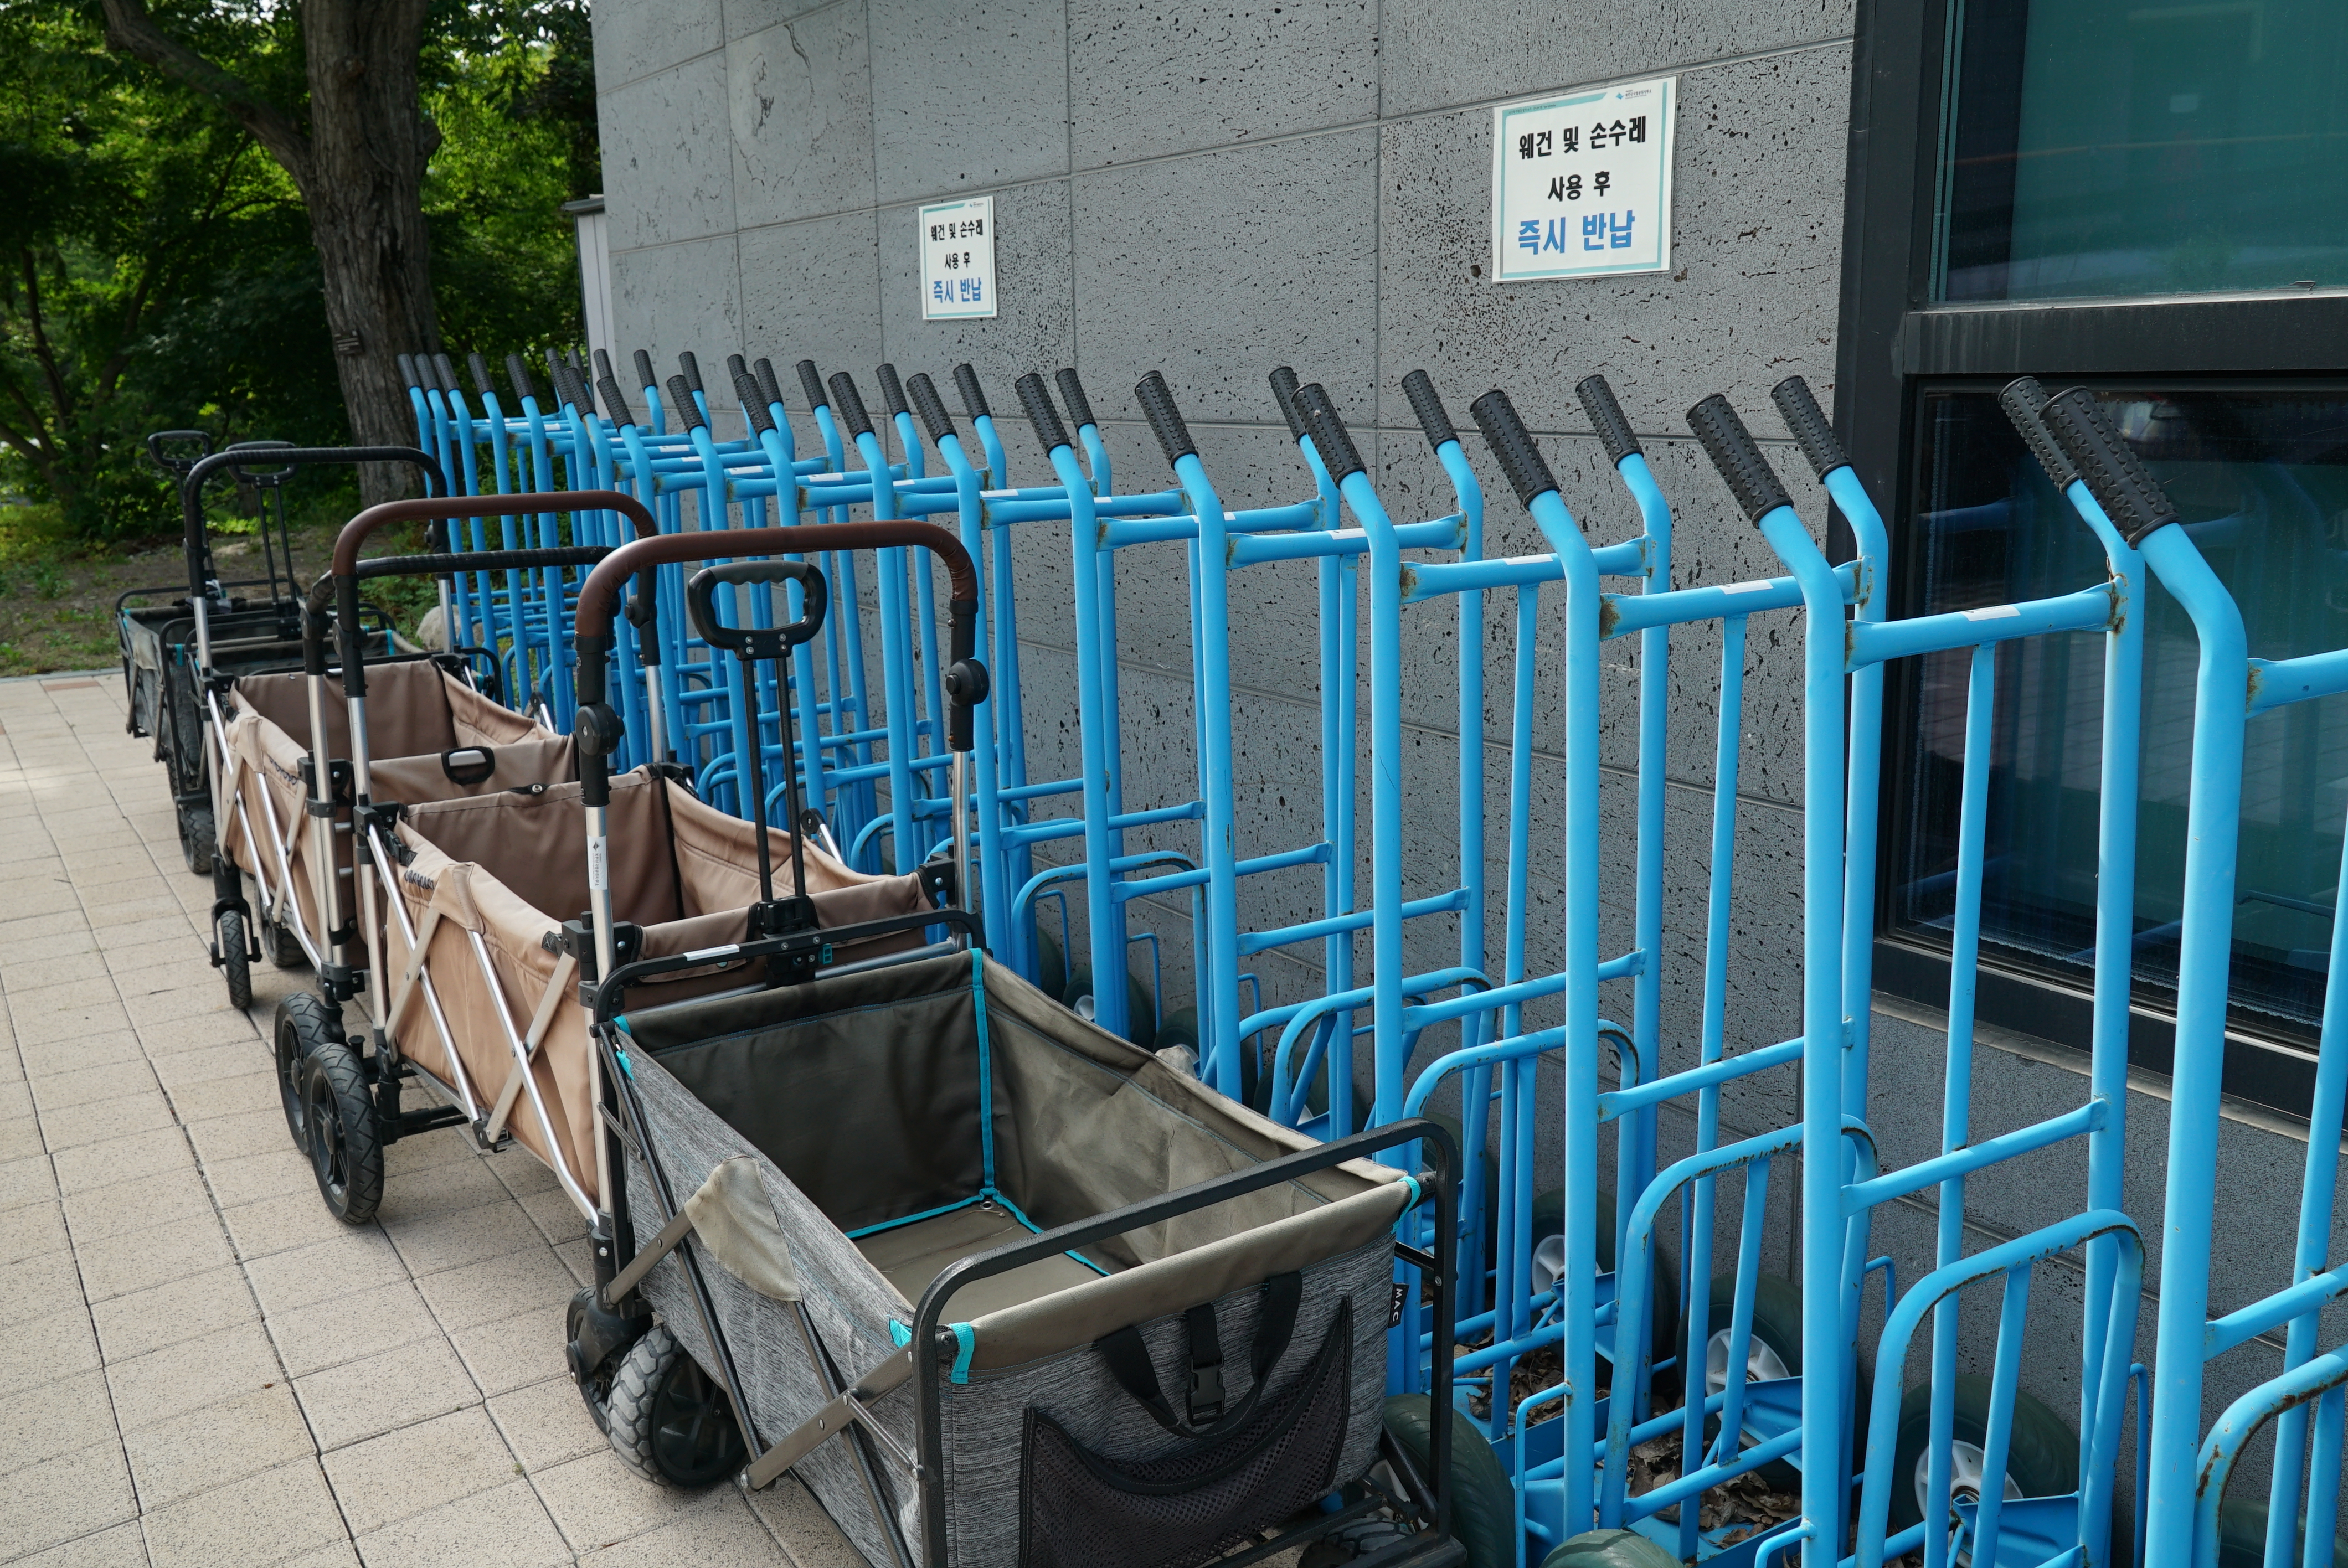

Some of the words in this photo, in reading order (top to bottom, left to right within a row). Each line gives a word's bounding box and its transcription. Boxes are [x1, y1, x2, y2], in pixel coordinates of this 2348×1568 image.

[1519, 131, 1552, 159] 웨건
[1564, 126, 1579, 153] 및
[1590, 116, 1646, 149] 손수레
[1548, 174, 1583, 202] 사용
[1594, 171, 1610, 197] 후
[931, 224, 945, 241] 웨건
[949, 222, 956, 239] 및
[960, 219, 983, 238] 손수레
[1518, 217, 1566, 255] 즉시
[1583, 210, 1635, 251] 반납
[945, 253, 959, 270] 사용
[964, 252, 970, 268] 후
[934, 280, 954, 303] 즉시
[960, 277, 981, 302] 반납
[1393, 1288, 1403, 1322] MAC
